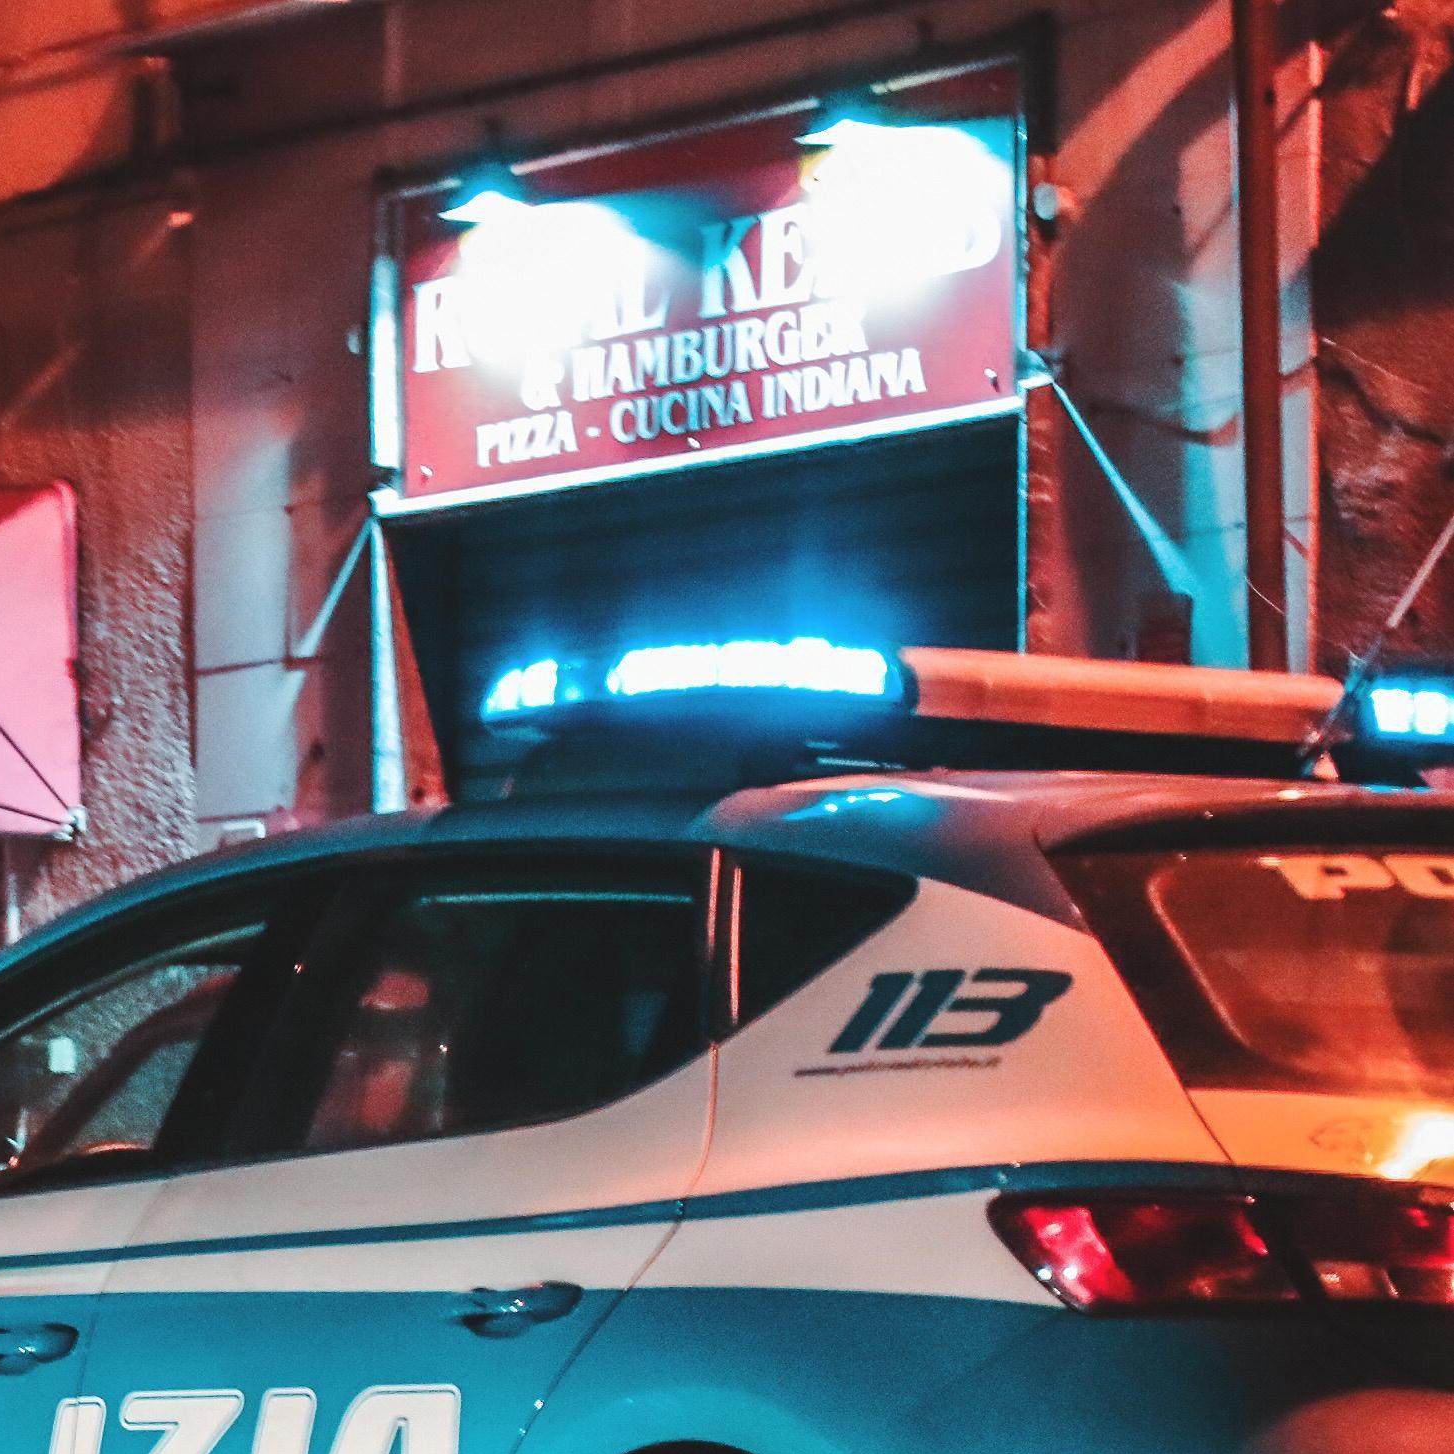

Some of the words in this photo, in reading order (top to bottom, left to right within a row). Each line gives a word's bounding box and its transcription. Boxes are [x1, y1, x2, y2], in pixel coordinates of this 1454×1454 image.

[571, 300, 868, 402] HAMBURGER
[475, 412, 577, 468] PIZZA
[609, 379, 753, 443] CUCINA
[760, 347, 926, 420] INDIANA
[828, 967, 1073, 1054] 113
